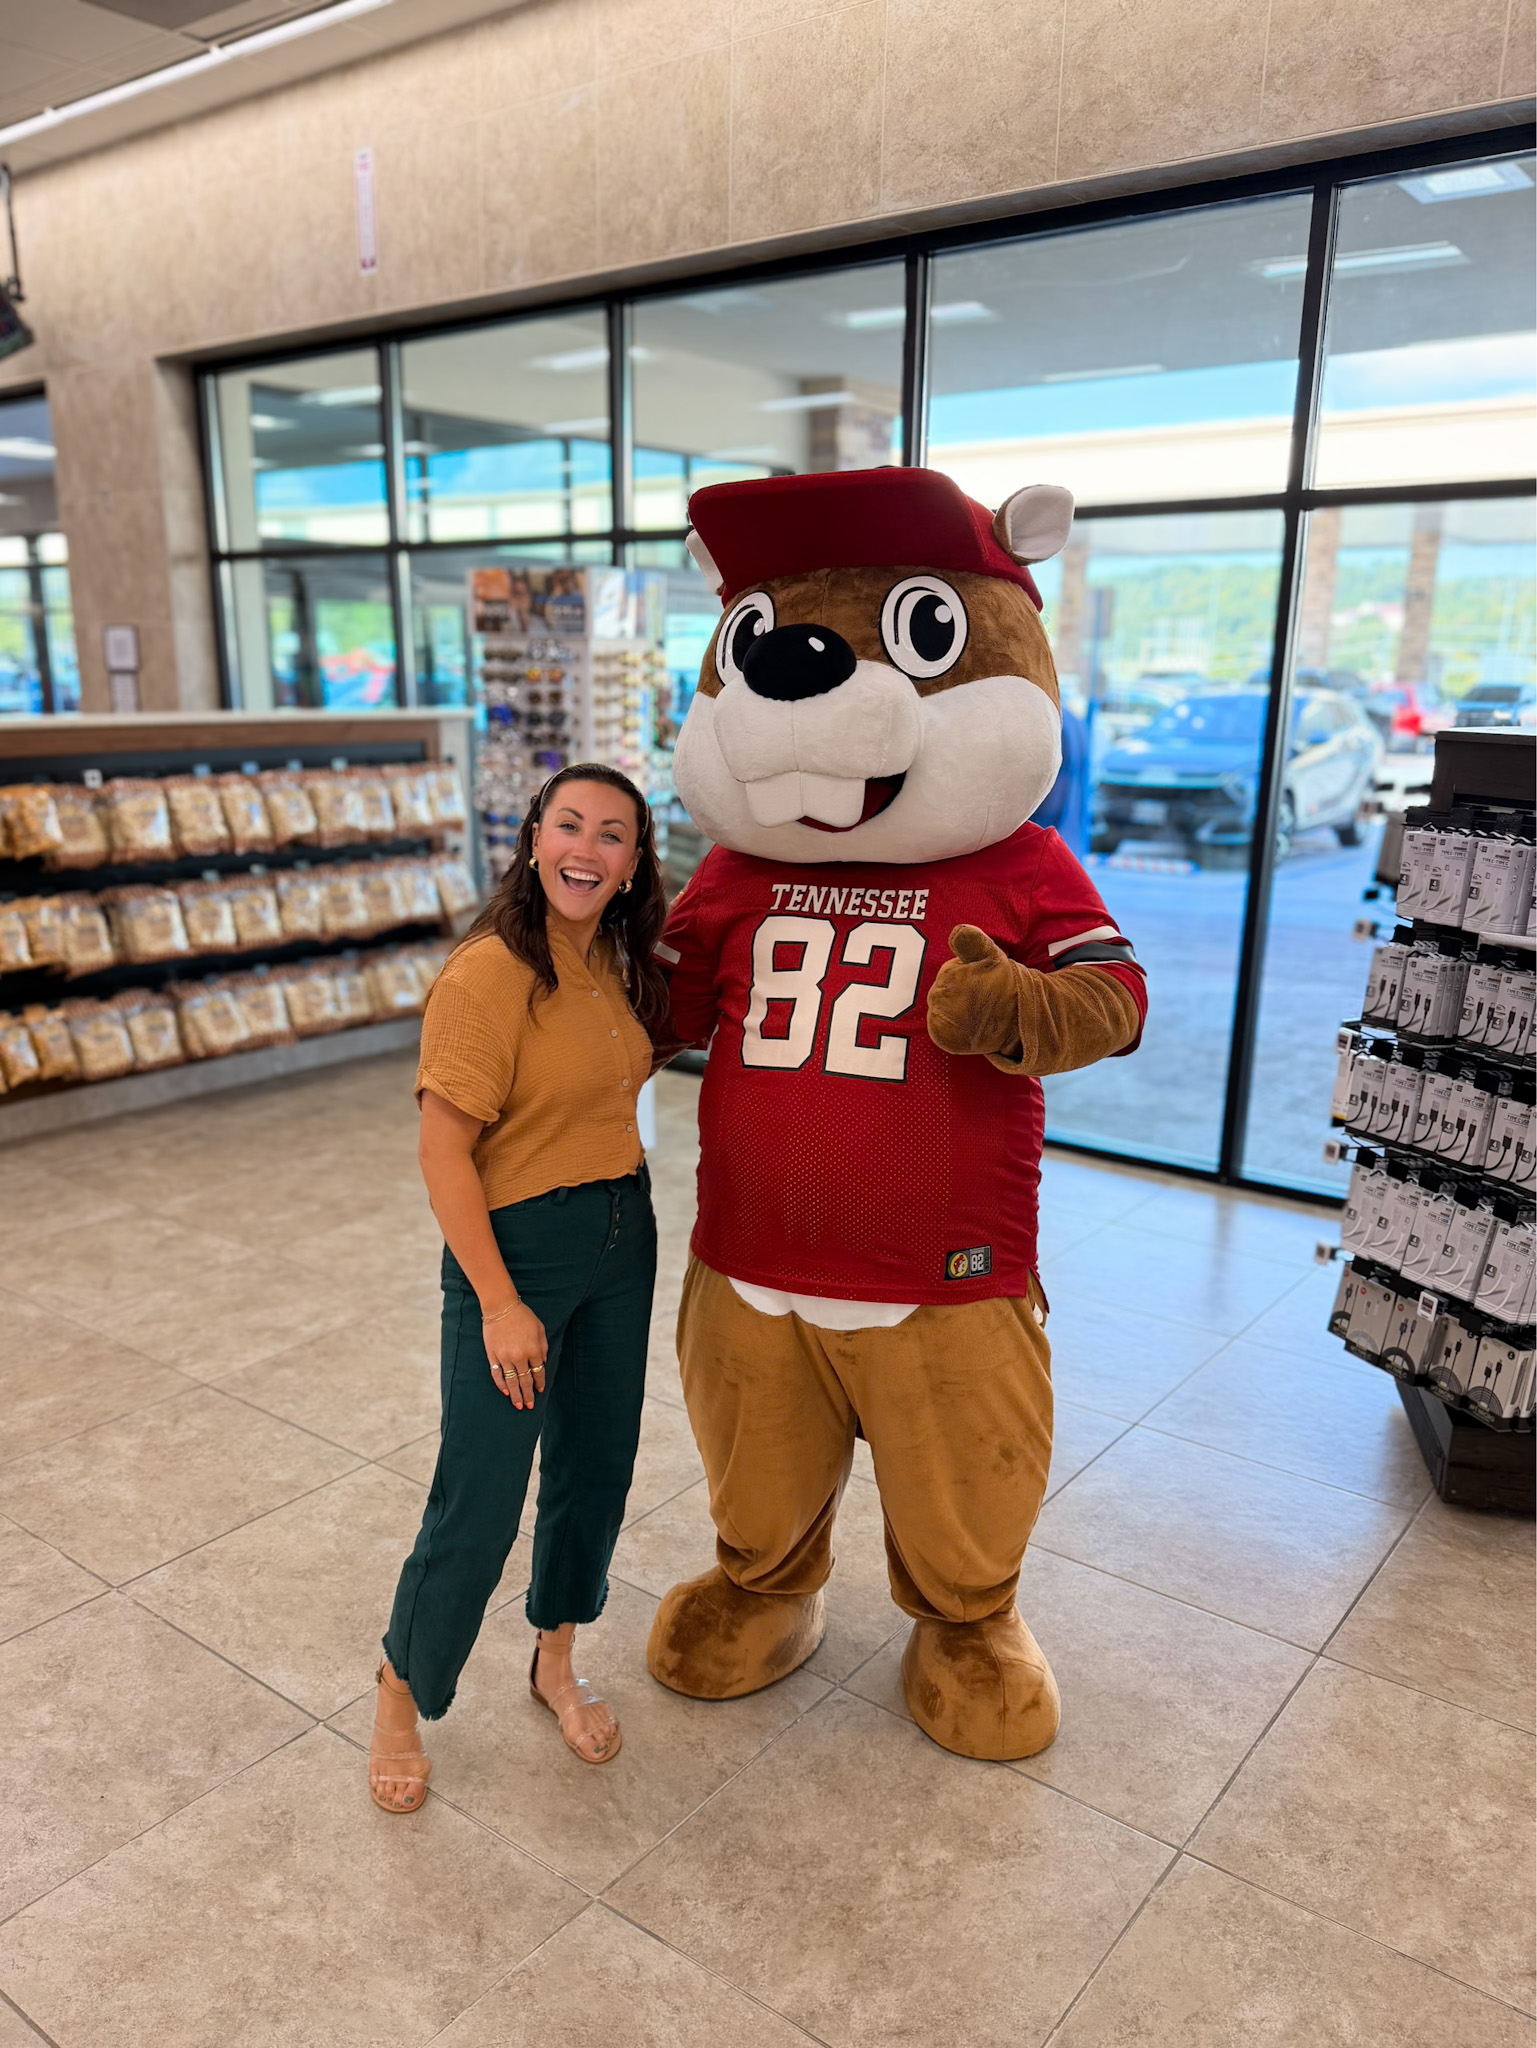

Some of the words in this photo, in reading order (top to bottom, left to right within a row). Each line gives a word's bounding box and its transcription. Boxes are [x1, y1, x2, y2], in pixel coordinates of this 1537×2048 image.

[770, 884, 929, 920] TENNESSEE
[741, 915, 929, 1083] 82
[971, 1253, 984, 1272] 82
